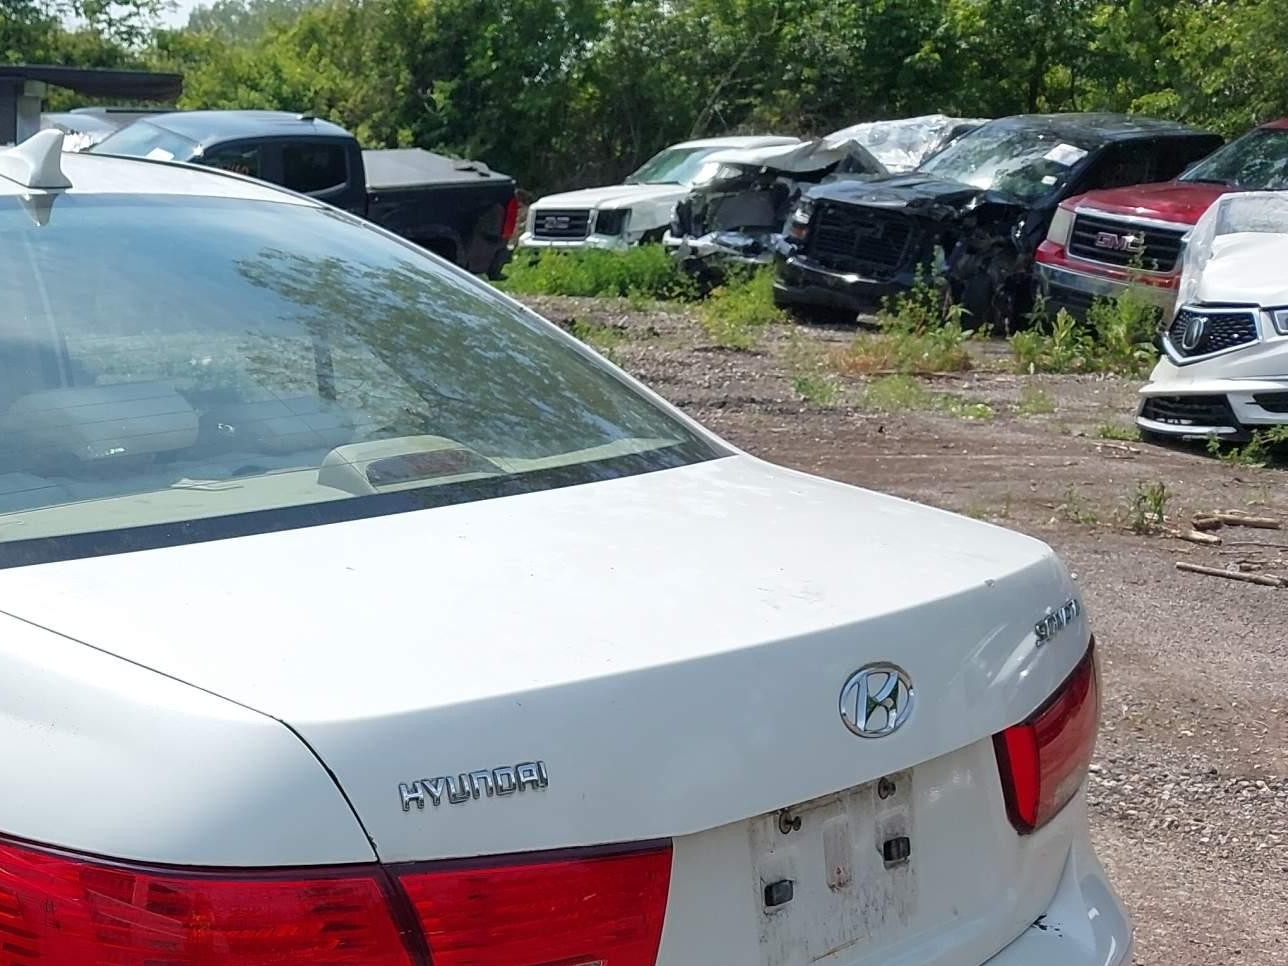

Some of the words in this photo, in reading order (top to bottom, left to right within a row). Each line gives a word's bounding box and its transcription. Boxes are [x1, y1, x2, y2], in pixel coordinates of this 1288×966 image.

[1095, 231, 1145, 253] GMC
[1034, 598, 1081, 648] SONAT
[399, 760, 549, 812] HYUNDAI
